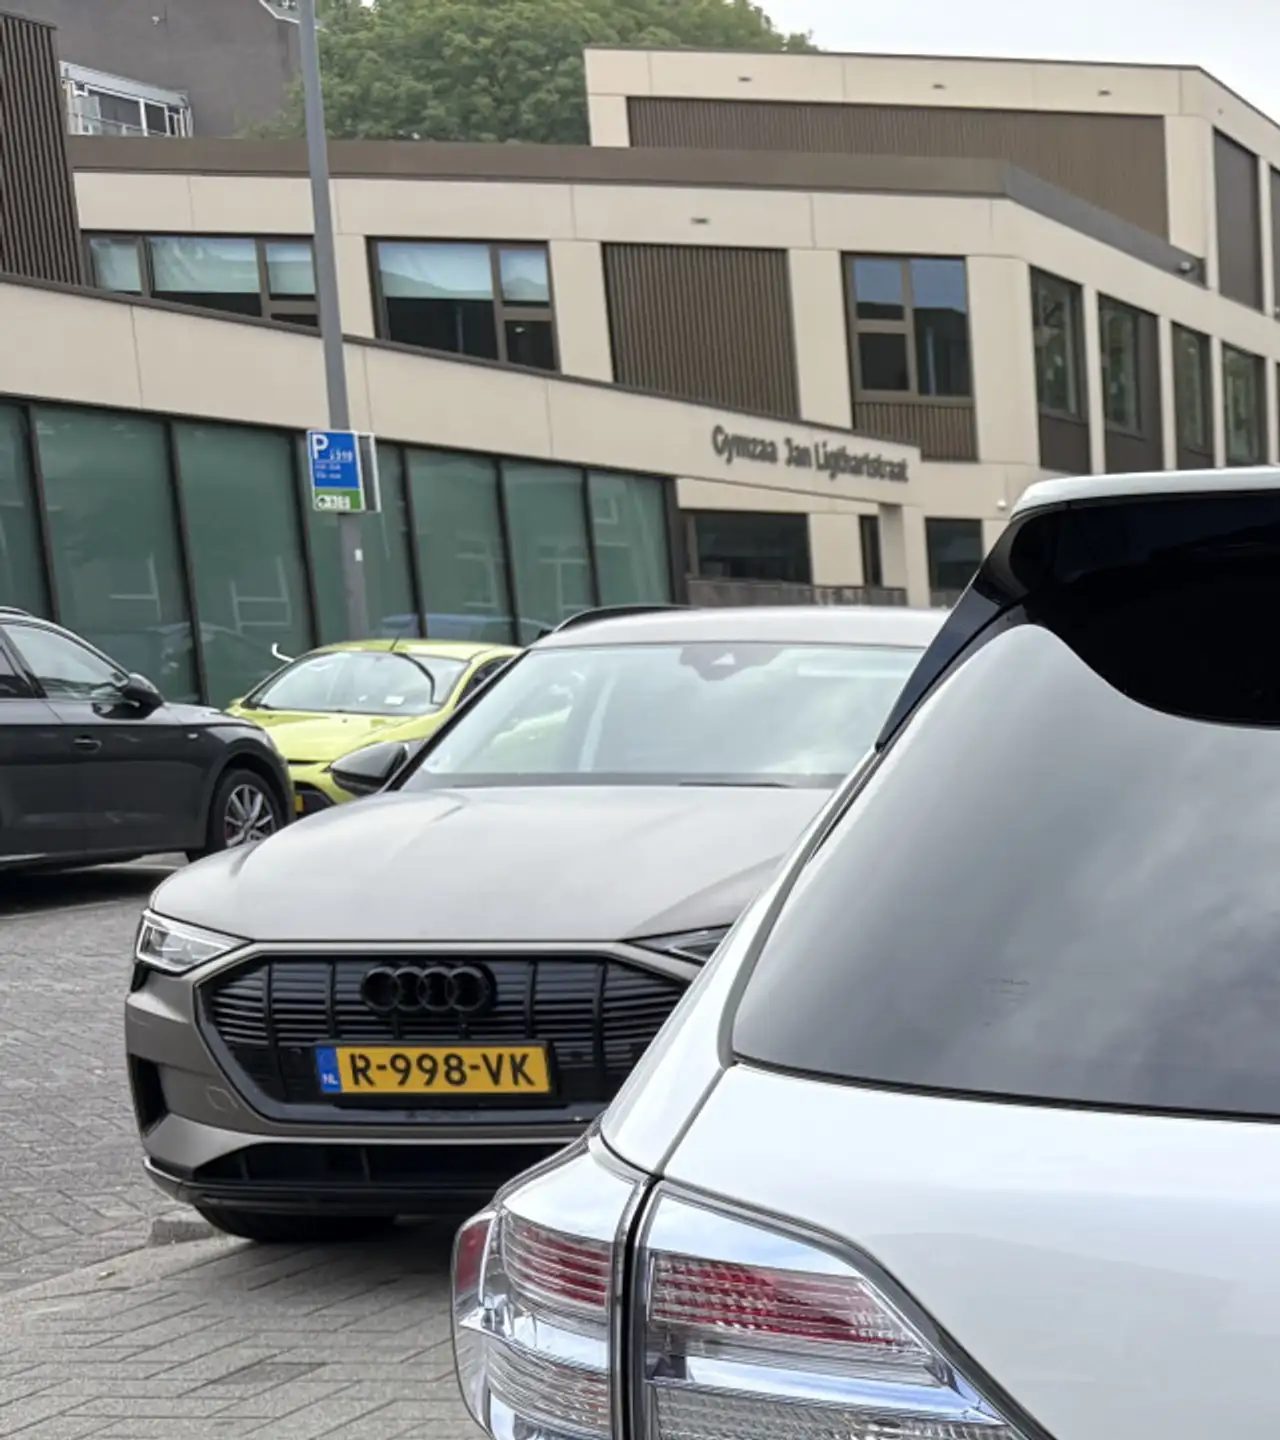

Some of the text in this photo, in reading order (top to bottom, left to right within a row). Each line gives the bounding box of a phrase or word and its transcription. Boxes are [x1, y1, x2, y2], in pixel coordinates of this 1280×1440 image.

[311, 434, 329, 459] P
[784, 437, 812, 467] Jan
[322, 1073, 339, 1085] NL
[349, 1053, 536, 1086] R-998-VK
